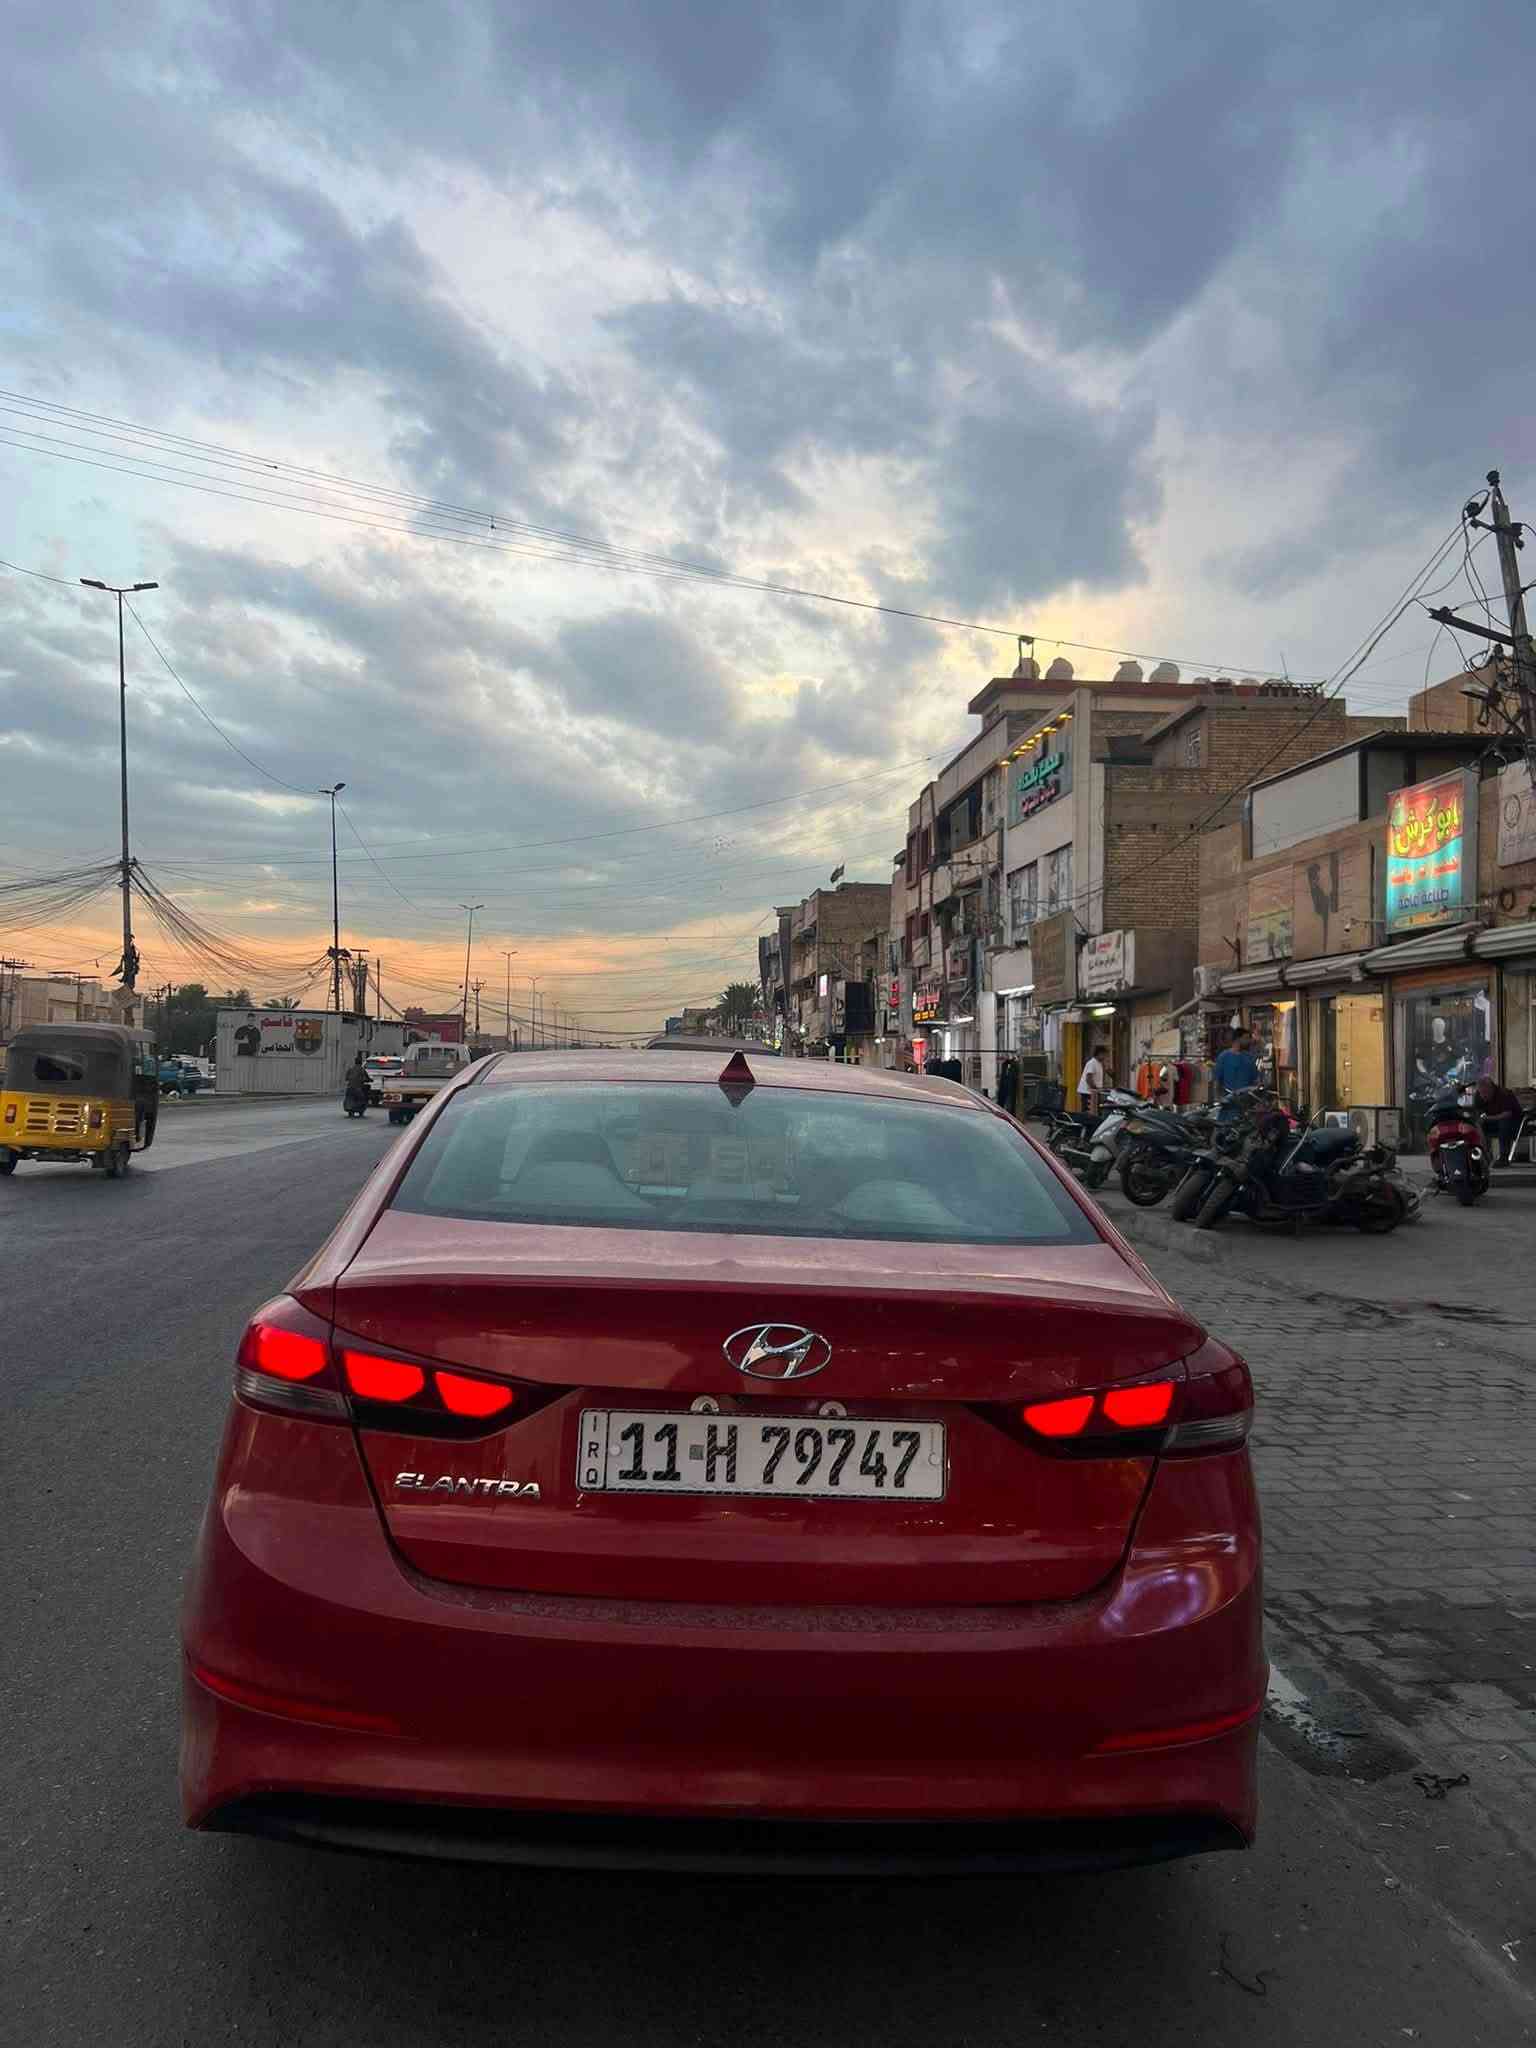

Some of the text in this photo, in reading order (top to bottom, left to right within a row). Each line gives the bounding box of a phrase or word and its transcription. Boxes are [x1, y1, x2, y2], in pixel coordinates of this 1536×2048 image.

[586, 1415, 600, 1484] IRQ
[618, 1422, 921, 1488] 11 H 79747
[394, 1472, 541, 1500] ELANTRA
